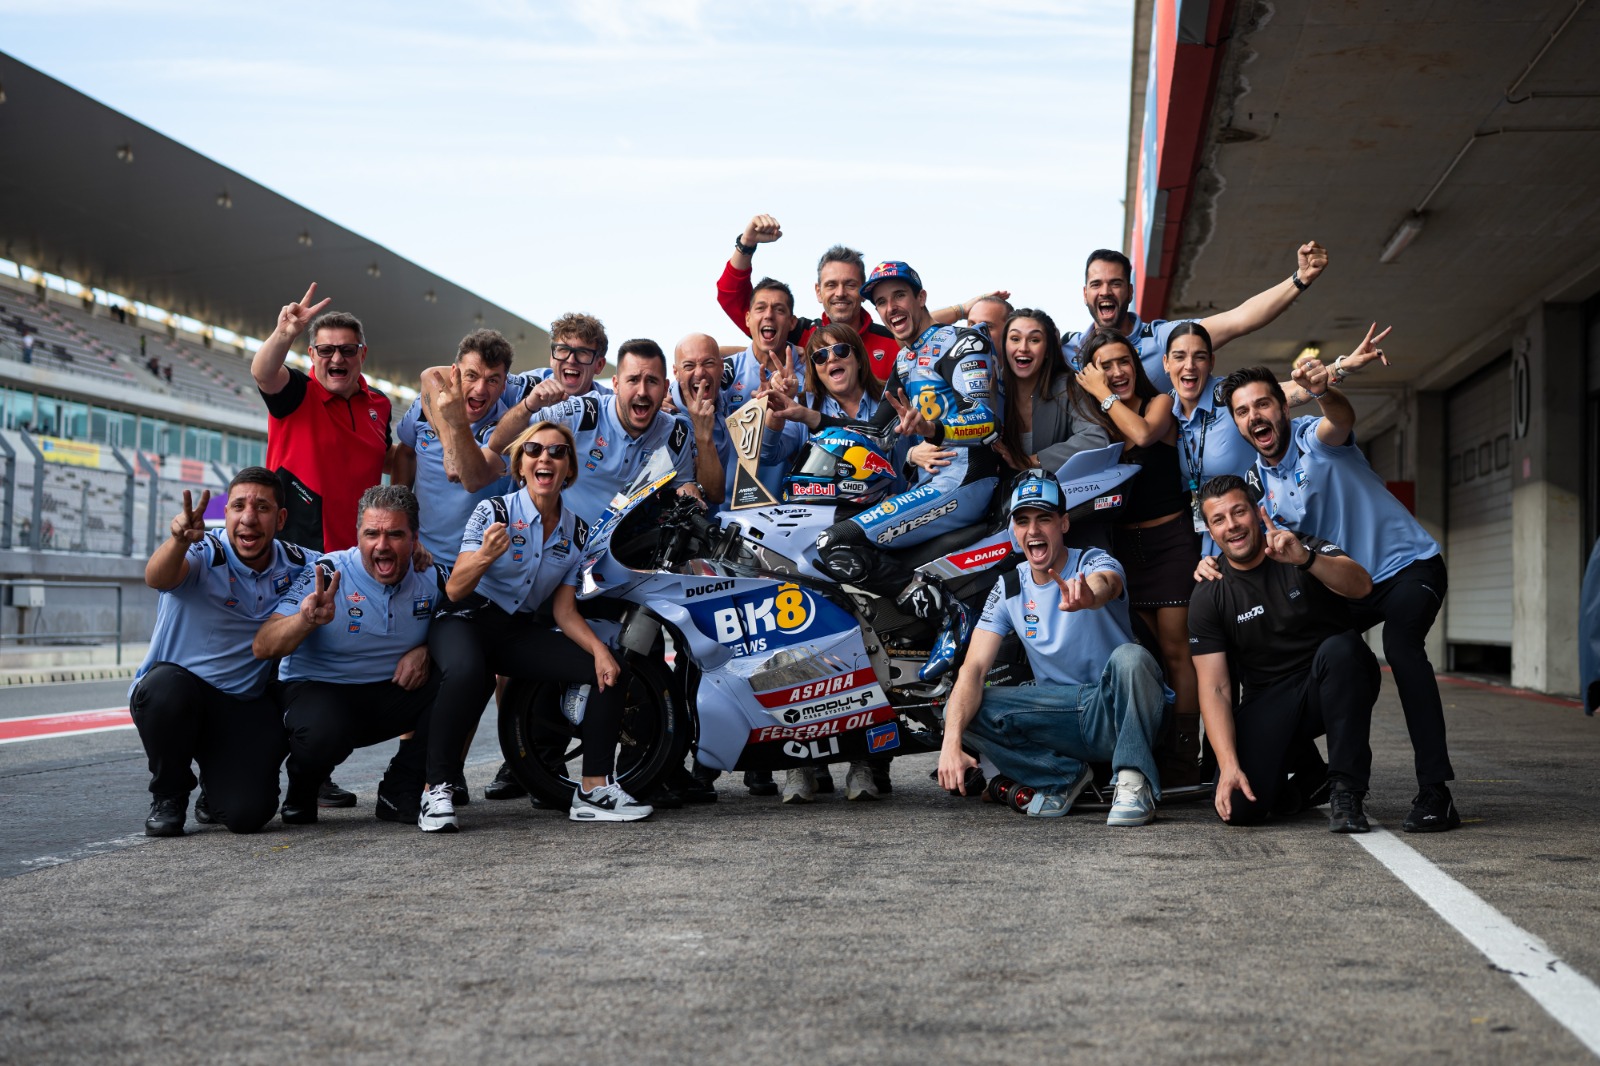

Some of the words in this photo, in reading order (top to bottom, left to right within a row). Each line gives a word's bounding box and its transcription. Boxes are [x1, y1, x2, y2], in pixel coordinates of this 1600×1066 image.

[961, 361, 979, 369] BOLD
[966, 413, 987, 421] NEWS
[954, 425, 990, 437] Antangin
[793, 482, 813, 495] Red
[813, 483, 835, 496] Bull
[842, 482, 864, 491] SHOEI
[1064, 484, 1100, 495] ISPOSTA
[859, 501, 898, 524] BK8
[896, 485, 935, 506] NEWS
[877, 499, 959, 544] alpinestars
[974, 547, 1007, 562] DAIKO
[685, 579, 736, 598] DUCATI
[714, 584, 810, 643] BK8
[788, 673, 854, 702] ASPIRA
[802, 690, 874, 716] MODULA
[824, 706, 851, 716] SYSTEM
[759, 722, 840, 741] FEDERAL
[845, 711, 875, 730] OIL
[783, 736, 840, 759] OLI
